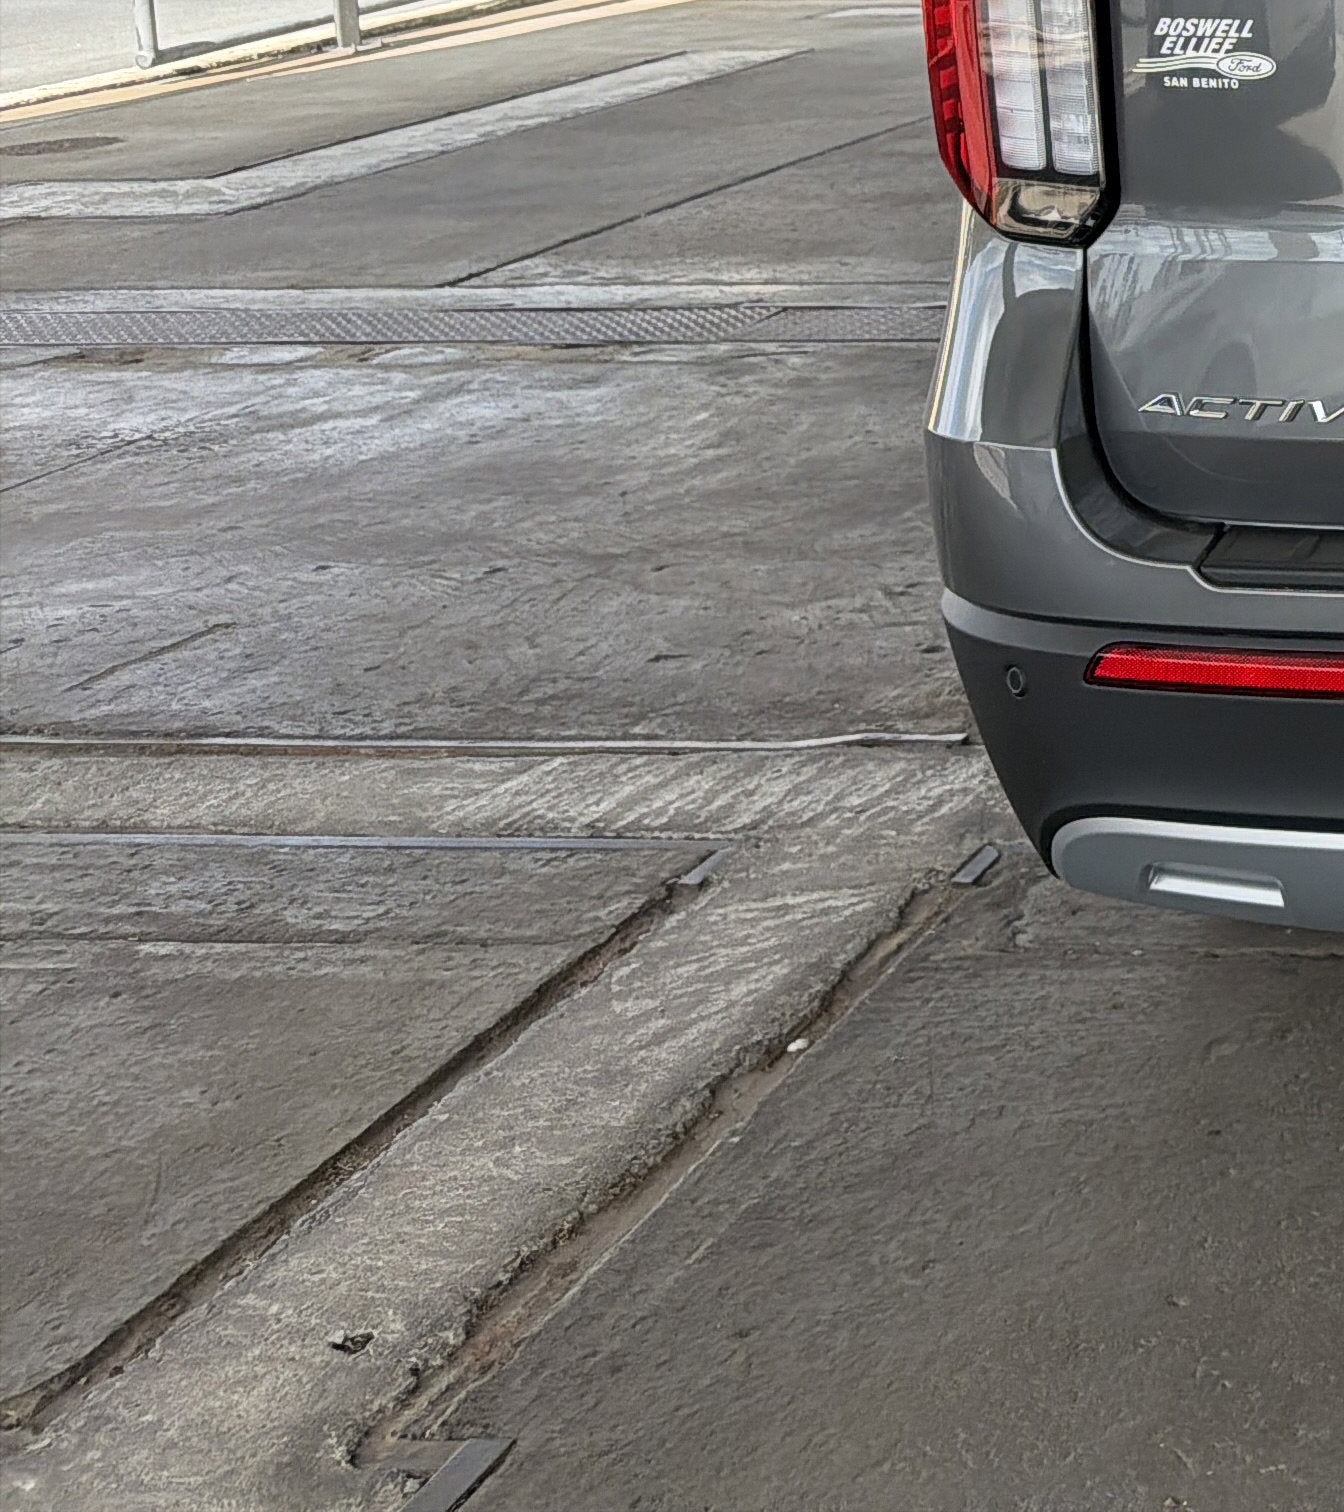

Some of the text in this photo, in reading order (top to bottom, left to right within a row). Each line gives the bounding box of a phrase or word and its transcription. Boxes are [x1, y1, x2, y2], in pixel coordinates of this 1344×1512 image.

[1153, 17, 1254, 38] BOSWELL
[1159, 36, 1239, 56] ELLIFF
[1227, 57, 1263, 73] Ford
[1163, 76, 1240, 89] SAN BENITO
